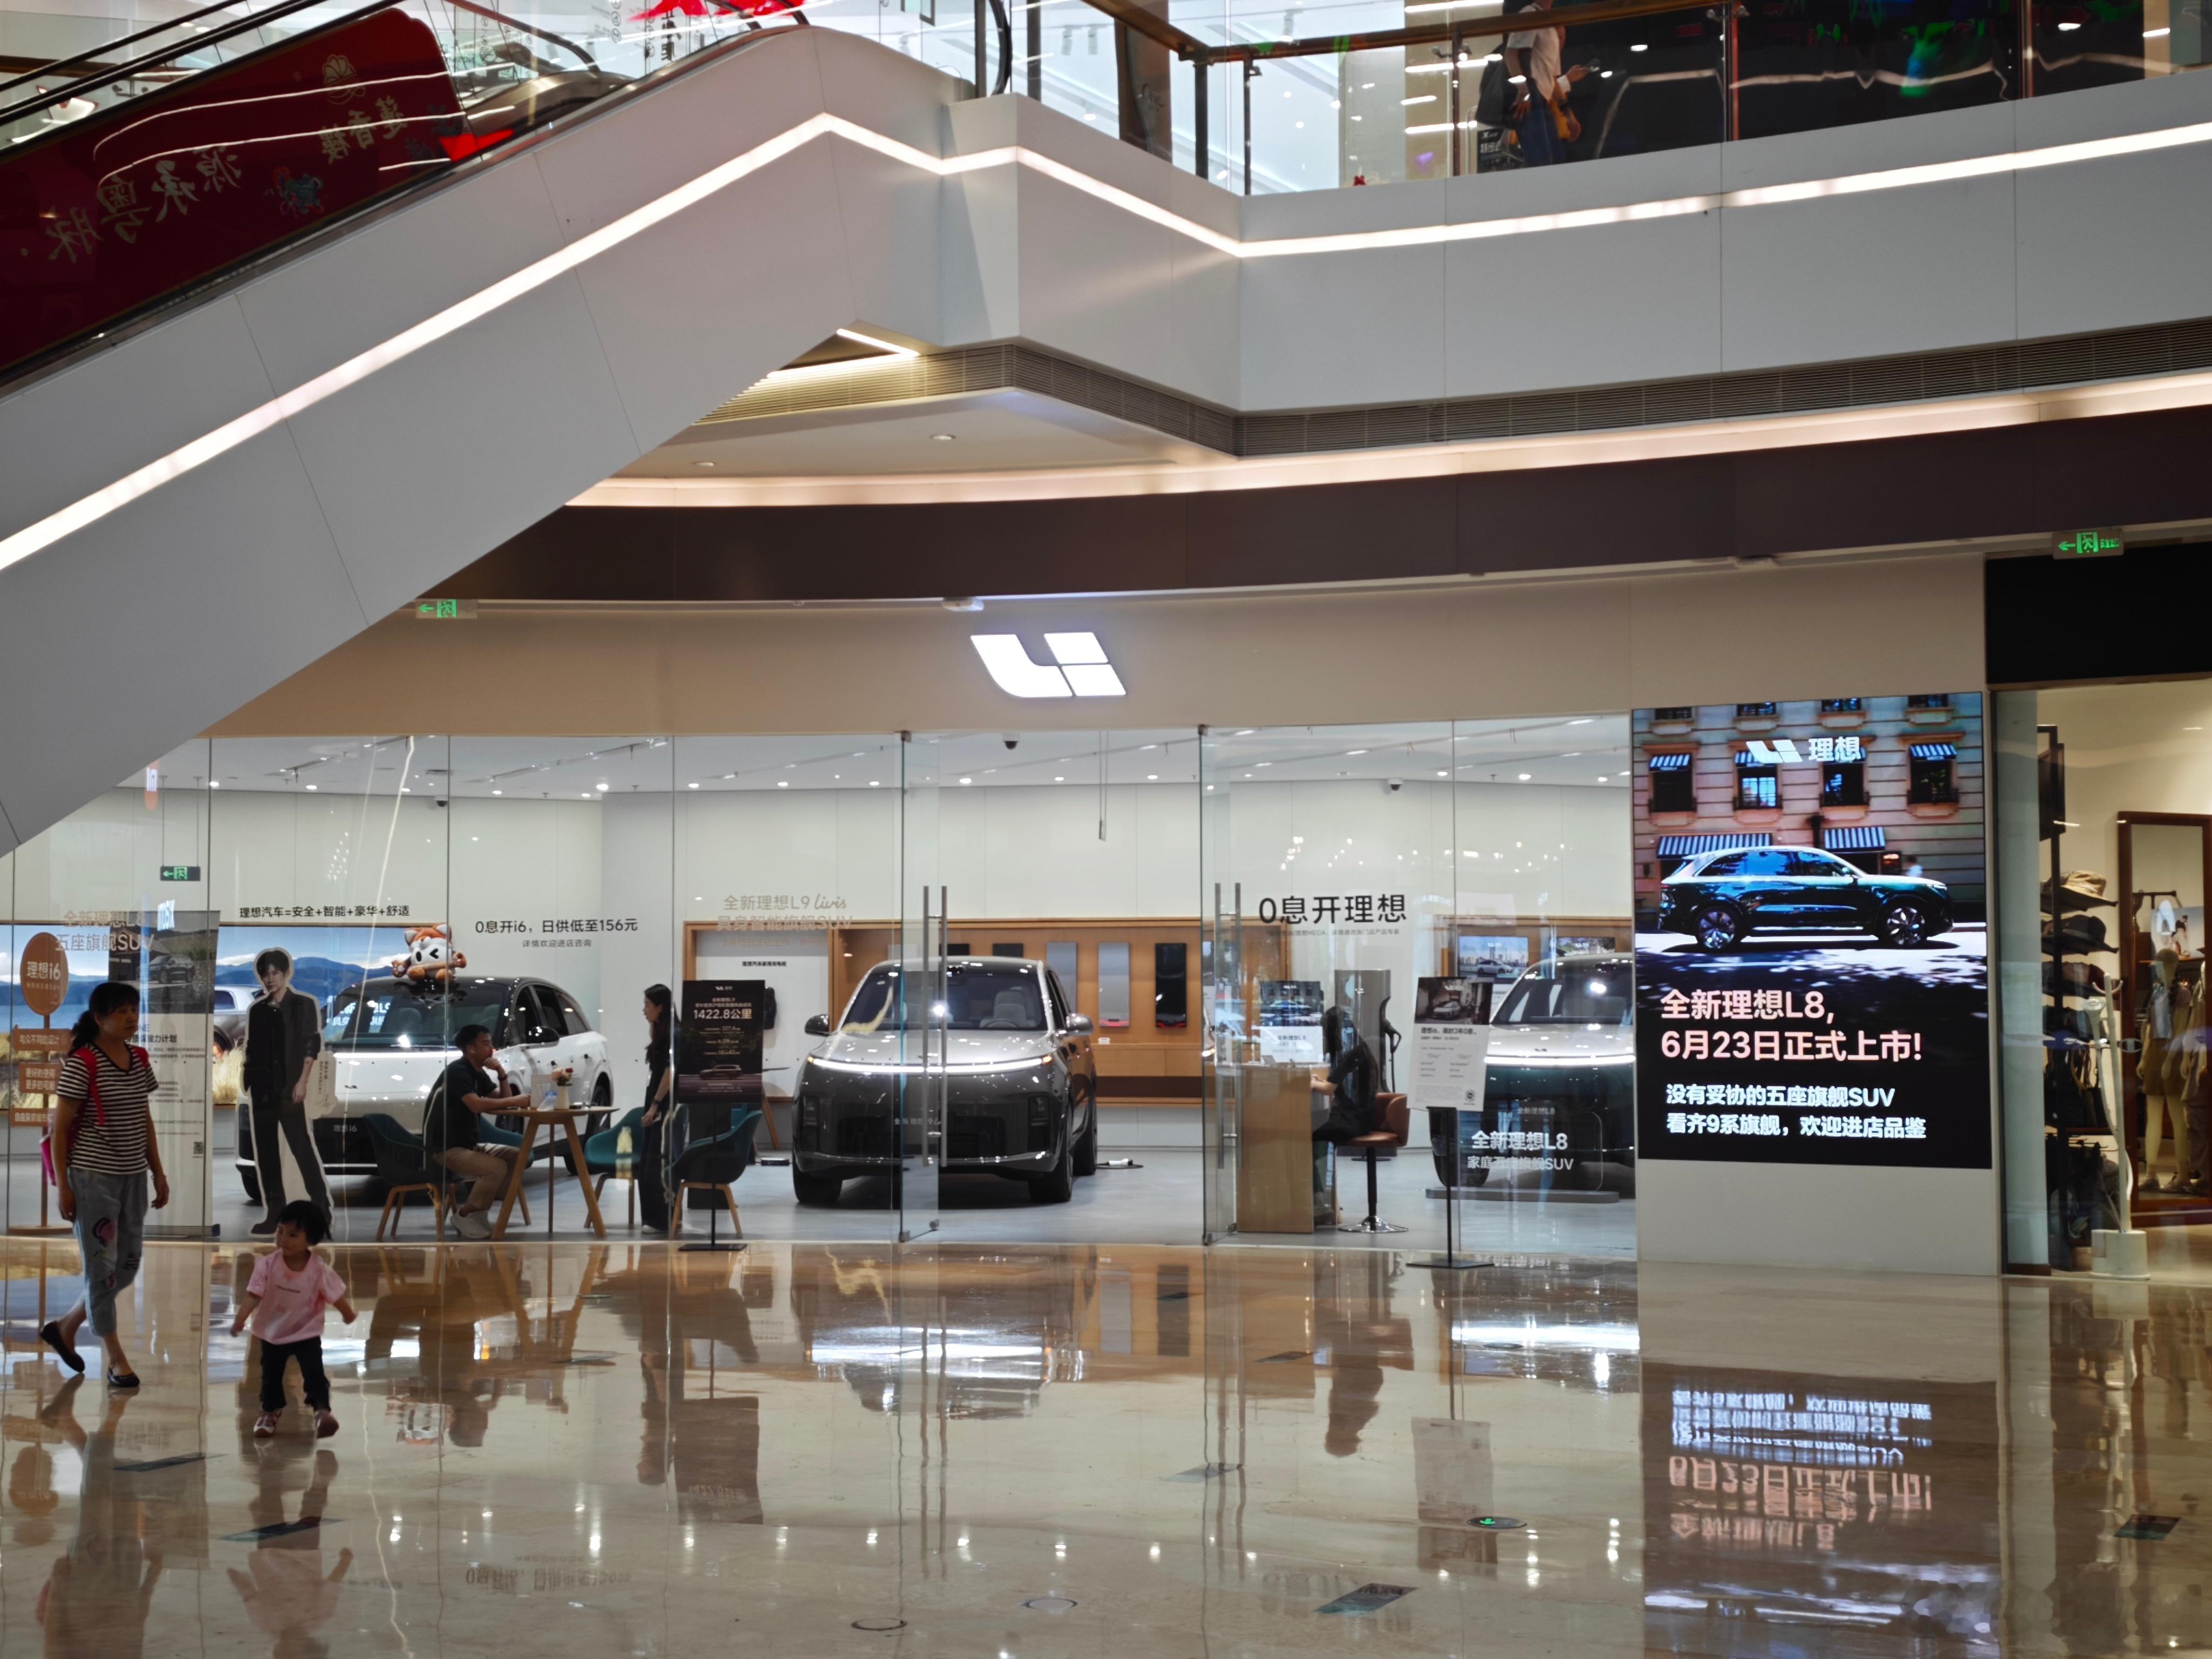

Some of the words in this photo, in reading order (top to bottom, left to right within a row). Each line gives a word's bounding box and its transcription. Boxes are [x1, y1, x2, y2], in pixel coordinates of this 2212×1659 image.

[1808, 736, 1862, 762] 理想
[239, 905, 410, 918] 理想汽车=安全+智能+豪华+舒适
[724, 895, 810, 911] 全新理想L9
[1259, 893, 1406, 925] 0息开理想
[55, 933, 154, 951] 五座旗舰SUV
[522, 939, 592, 948] 详情欢迎进店咨询
[26, 961, 61, 980] 理想i6
[693, 1008, 753, 1020] 1422.8公里
[1665, 1083, 1896, 1109] 没有妥协的五座旗舰SUV
[1666, 1111, 1927, 1140] 看齐9系旗舰，欢迎进店品鉴
[1471, 1130, 1568, 1151] 全新理想L8
